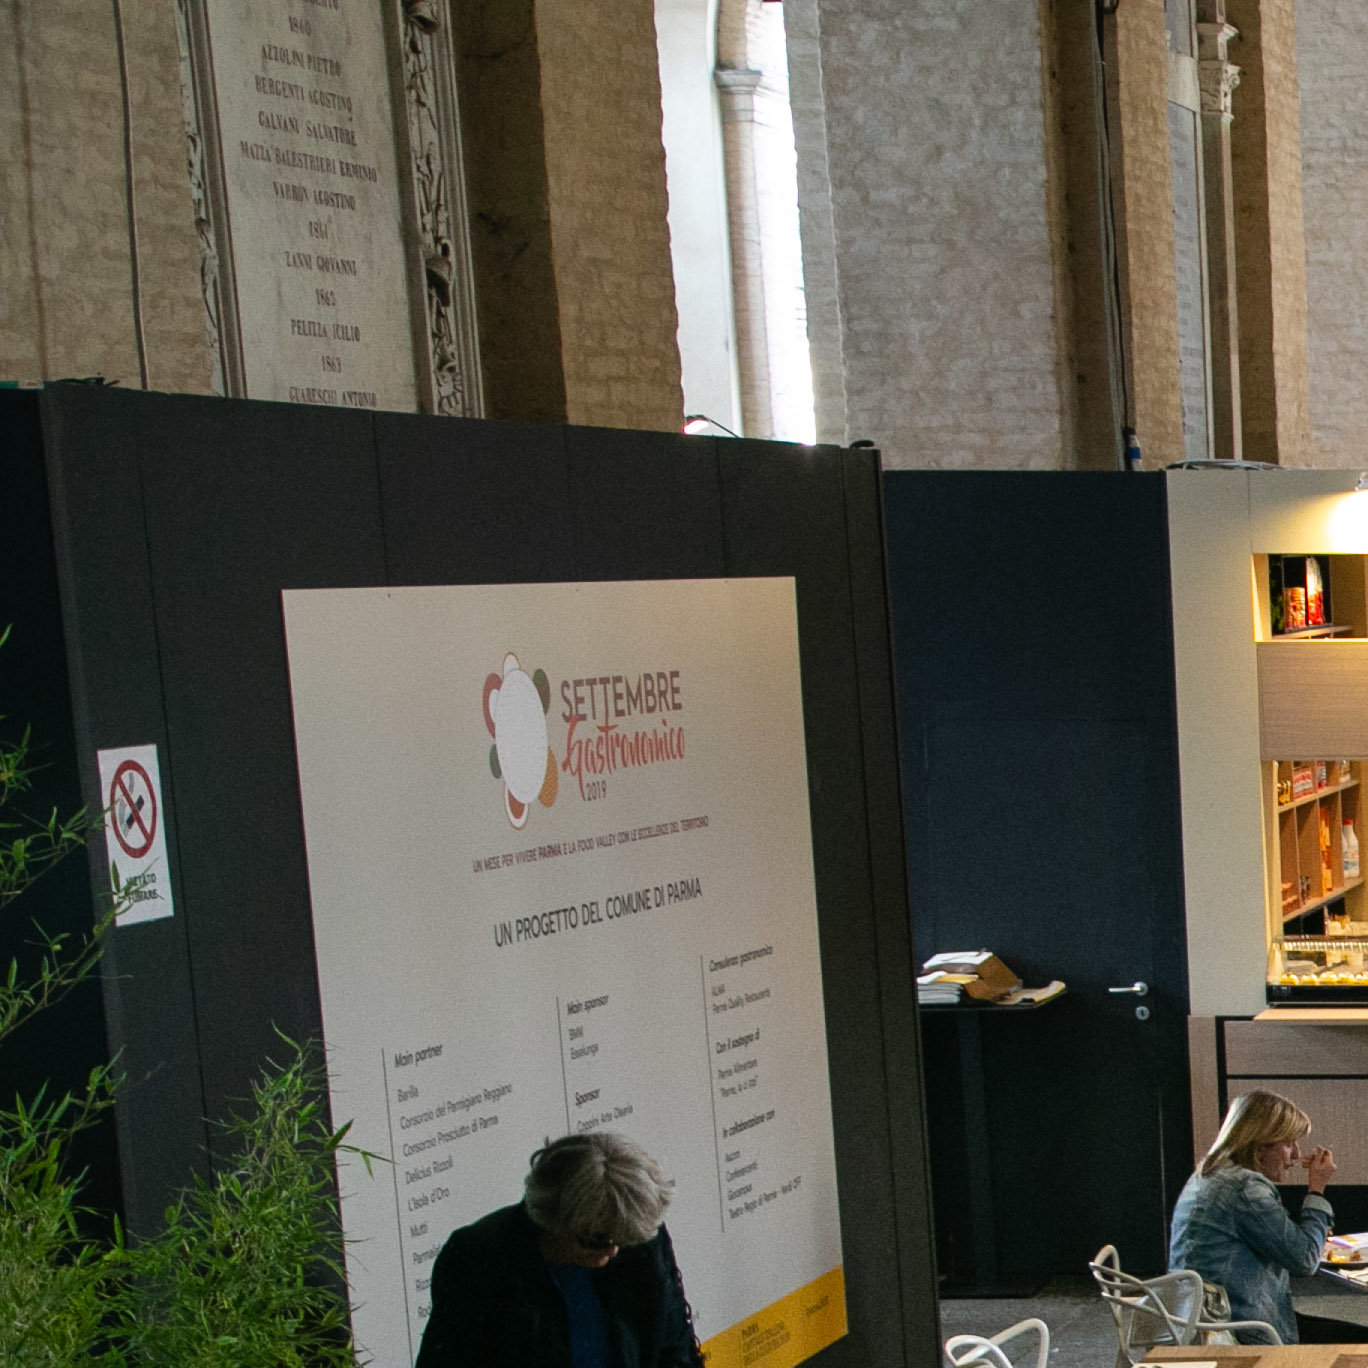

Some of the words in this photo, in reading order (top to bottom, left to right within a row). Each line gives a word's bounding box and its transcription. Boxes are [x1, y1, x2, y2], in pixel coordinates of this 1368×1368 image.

[316, 255, 357, 276] GIOVANNI
[561, 671, 682, 724] SETTEMBRE
[562, 714, 685, 801] Gastronomico
[586, 780, 607, 801] 2019
[538, 845, 562, 861] PARMA
[577, 838, 594, 852] FOOD
[595, 834, 617, 849] VALLEY
[494, 920, 513, 947] UN
[516, 906, 579, 942] PROGETTO
[581, 901, 603, 926] DEL
[605, 889, 652, 920] COMUNE
[654, 885, 665, 908] DI
[668, 877, 703, 906] PARMA
[394, 1050, 414, 1068] Main
[415, 1045, 442, 1066] partner
[400, 1109, 434, 1130] Consorzio
[402, 1137, 436, 1157] Consorzio
